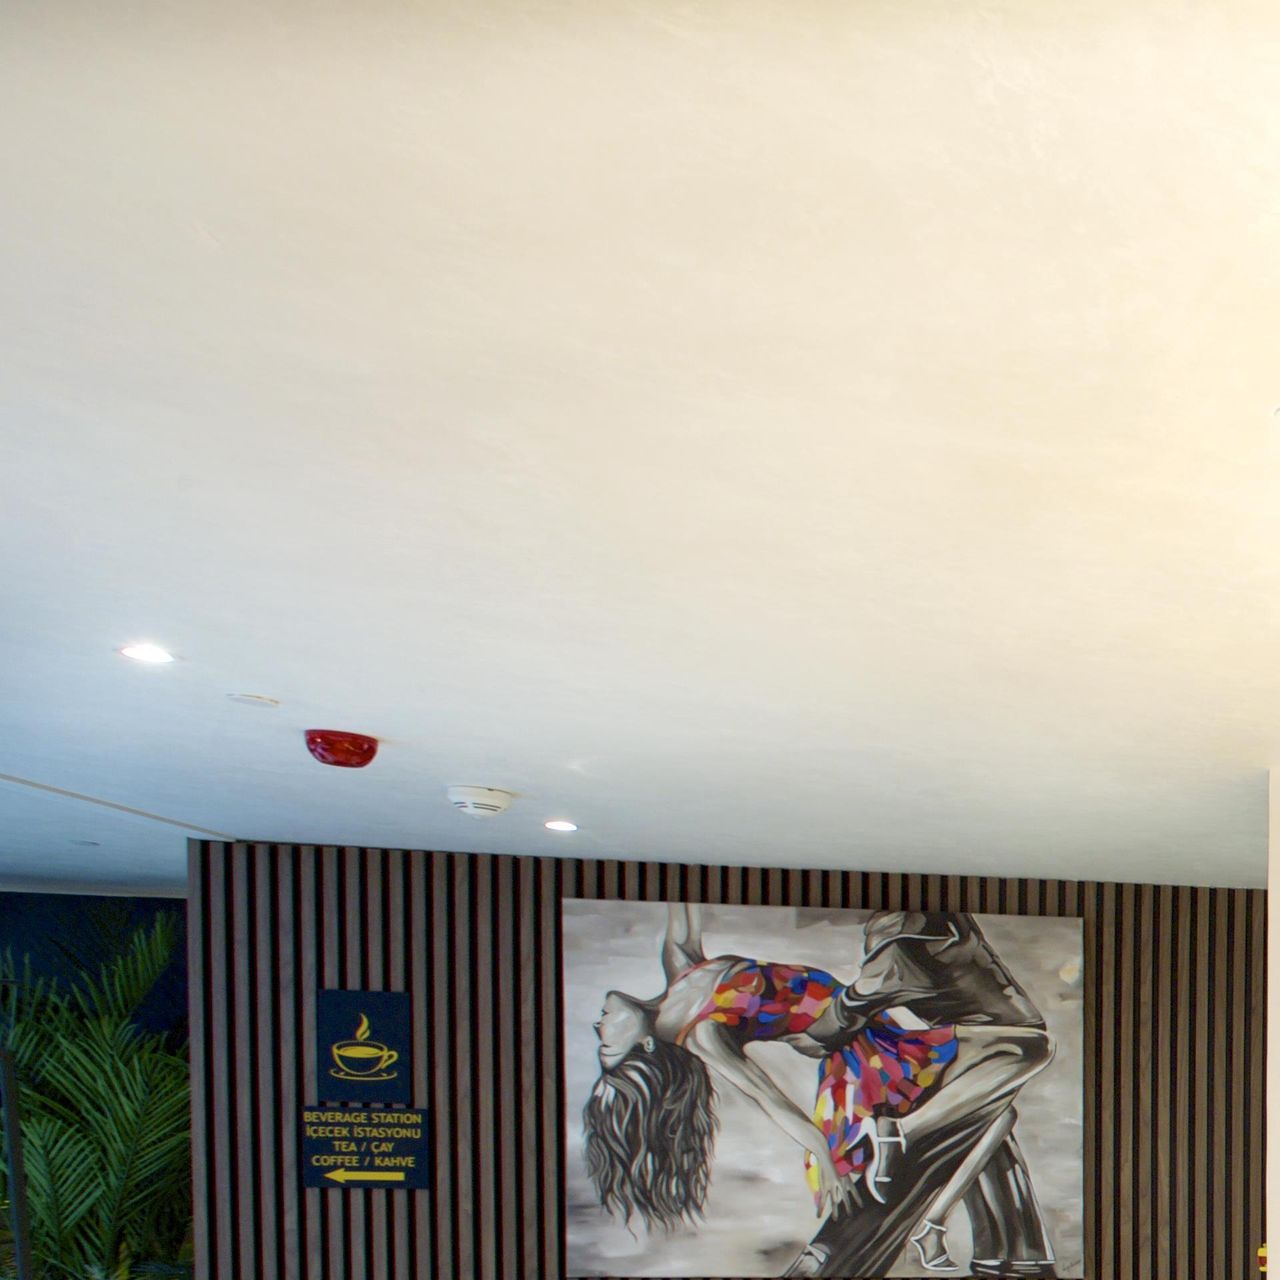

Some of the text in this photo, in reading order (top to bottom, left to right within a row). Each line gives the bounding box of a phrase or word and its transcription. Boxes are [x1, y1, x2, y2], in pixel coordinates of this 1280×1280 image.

[303, 1111, 422, 1124] BEVERAGE STATION
[305, 1124, 421, 1139] İÇECEK İSTASYONU
[333, 1141, 395, 1154] TEA / ÇAY
[311, 1155, 416, 1167] COFFEE / KAHVE
